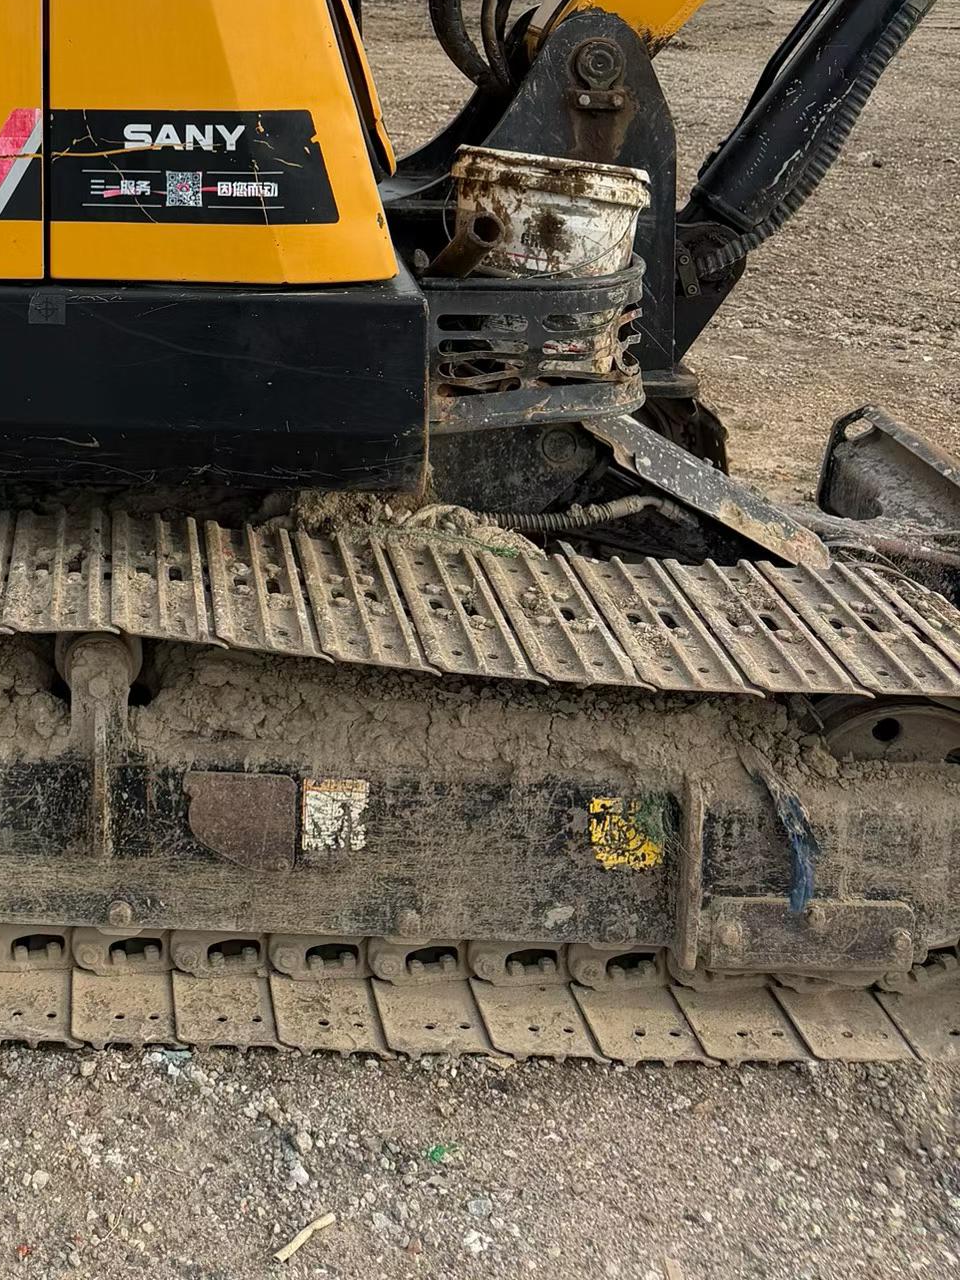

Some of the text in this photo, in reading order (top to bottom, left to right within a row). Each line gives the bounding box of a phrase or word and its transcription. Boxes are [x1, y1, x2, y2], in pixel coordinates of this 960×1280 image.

[123, 123, 246, 151] SANY
[90, 179, 151, 196] 三一服务
[217, 181, 279, 197] 因您而动
